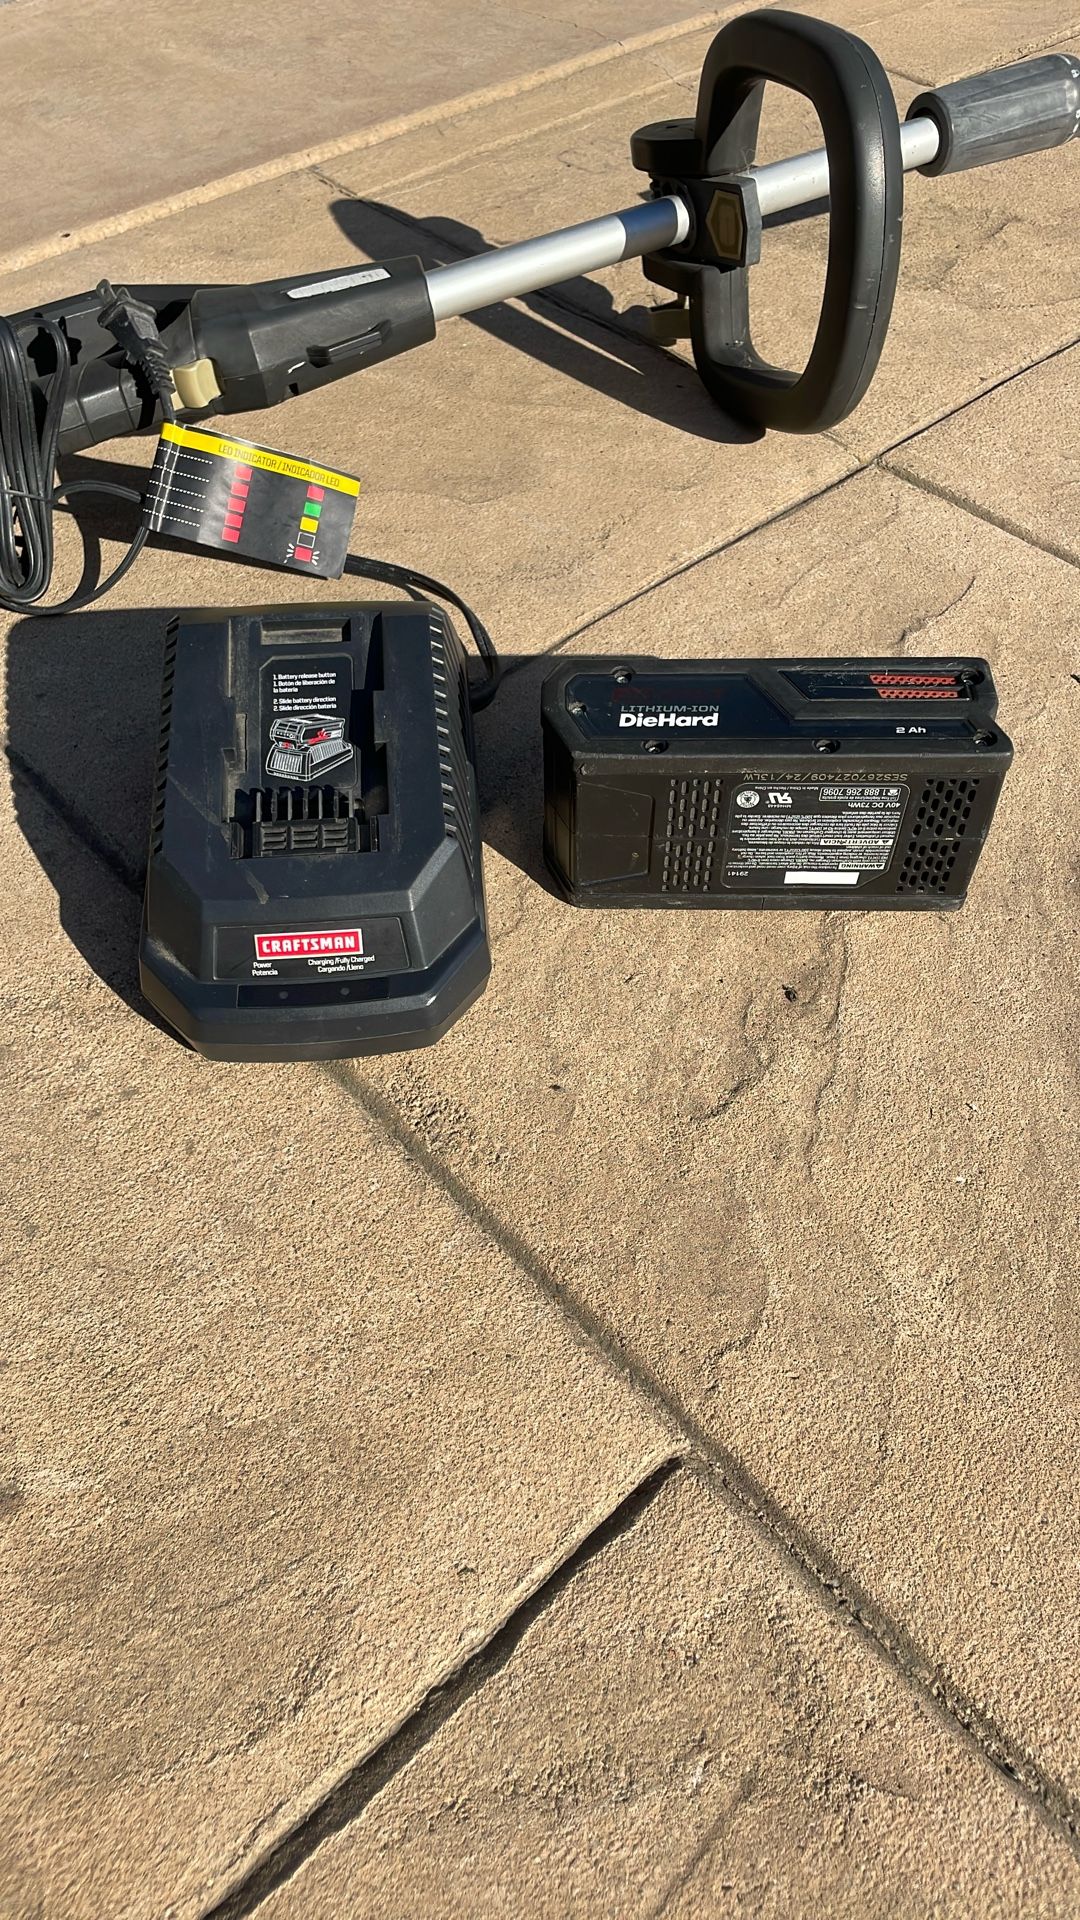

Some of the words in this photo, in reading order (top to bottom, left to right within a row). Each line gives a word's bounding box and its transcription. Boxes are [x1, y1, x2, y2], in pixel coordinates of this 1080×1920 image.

[218, 443, 233, 456] LED
[234, 447, 277, 468] INDICATOR
[282, 463, 326, 482] INDICADOR
[325, 476, 340, 487] LED
[619, 712, 719, 727] DieHard
[823, 788, 844, 796] 7096
[846, 788, 862, 796] 266
[864, 788, 880, 796] 888
[262, 936, 355, 953] CRAFTSMAN
[308, 958, 335, 967] Charging
[350, 955, 375, 964] Charged
[317, 965, 346, 973] Cargando
